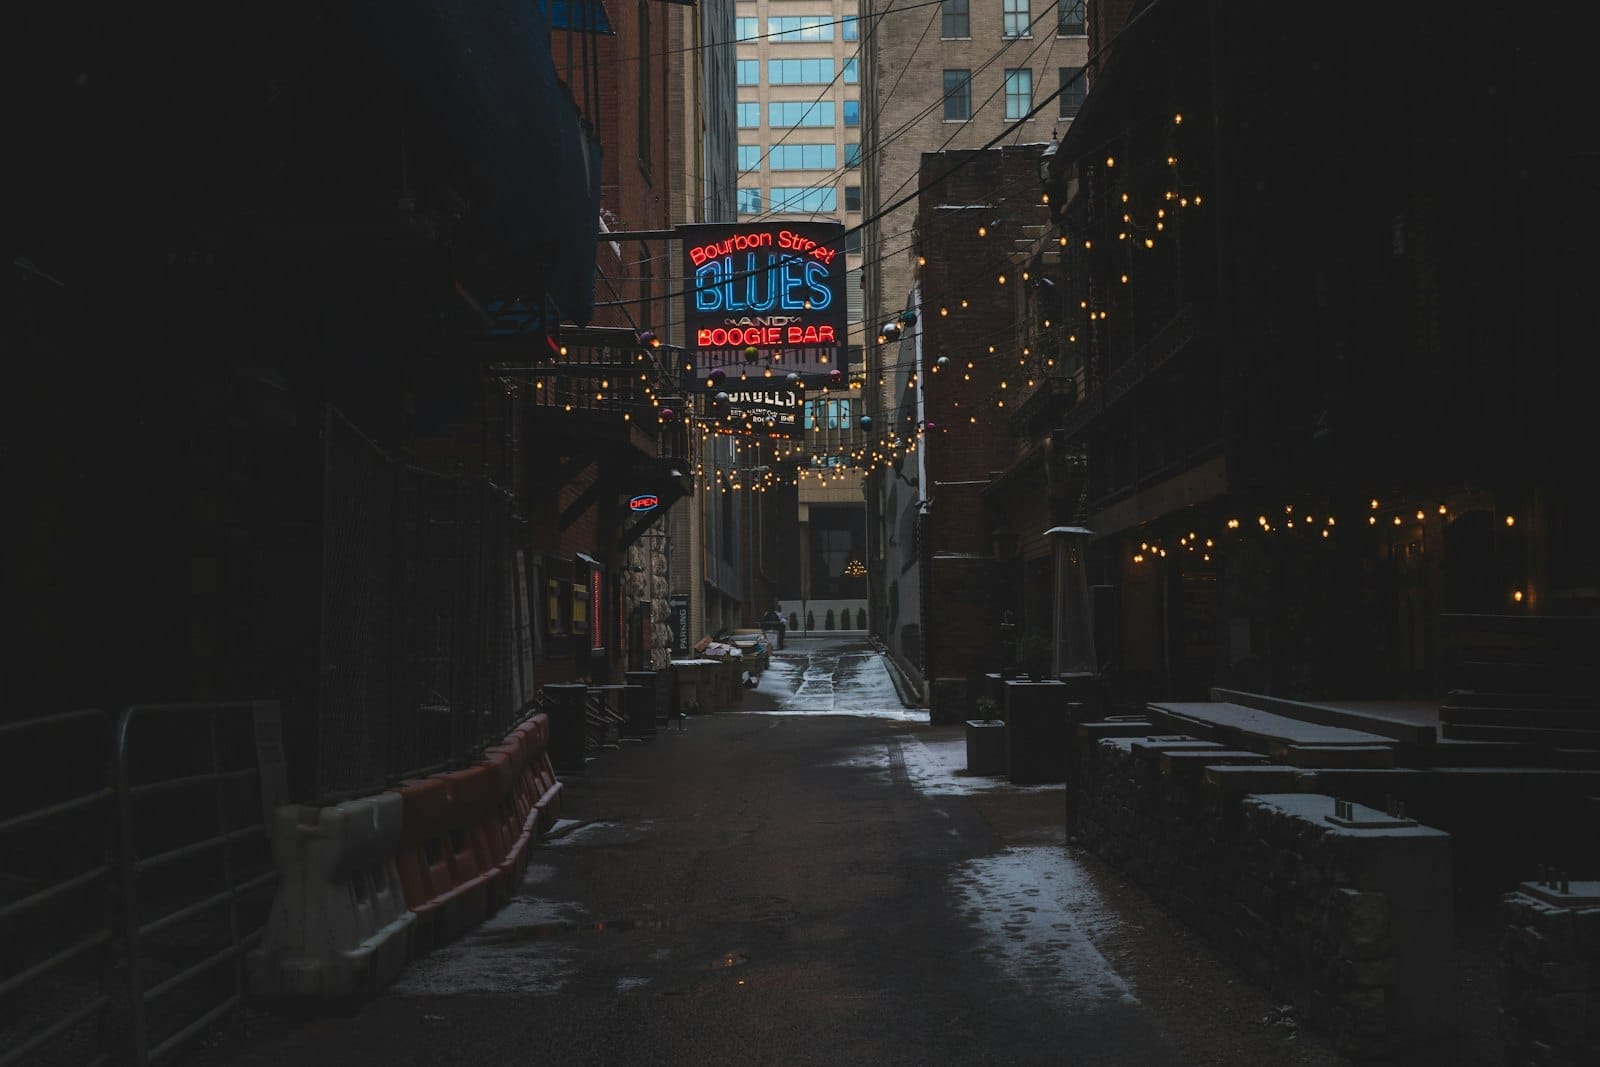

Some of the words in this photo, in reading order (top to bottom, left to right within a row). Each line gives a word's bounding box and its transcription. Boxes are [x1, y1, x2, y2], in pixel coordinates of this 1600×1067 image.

[689, 232, 772, 266] Bourbon
[777, 230, 836, 265] Street
[695, 251, 832, 312] BLUES
[697, 327, 783, 347] BOOGIE
[788, 325, 836, 344] BAR
[734, 316, 790, 327] AND
[630, 497, 658, 508] OPEN
[679, 608, 687, 649] PARKING
